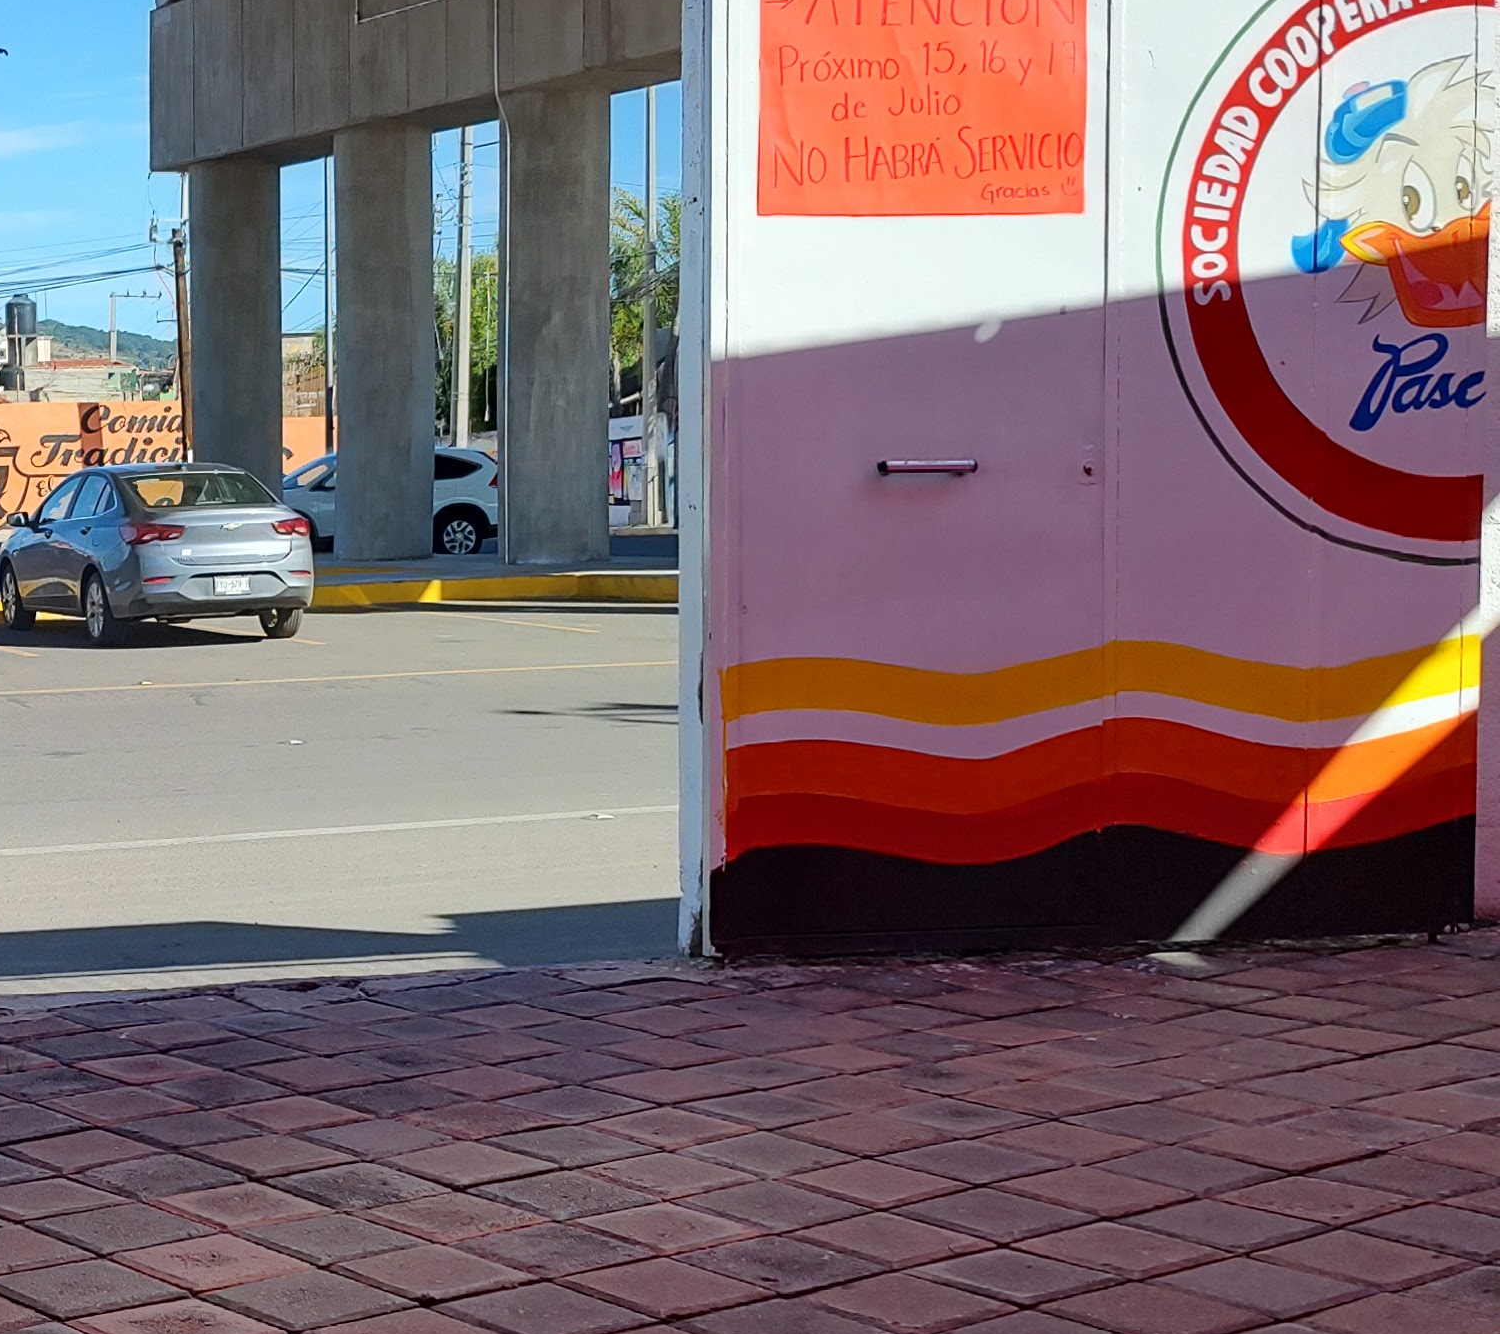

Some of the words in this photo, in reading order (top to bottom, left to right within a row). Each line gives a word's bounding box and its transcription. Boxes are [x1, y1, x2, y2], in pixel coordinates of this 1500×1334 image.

[779, 44, 900, 86] Próximo
[922, 40, 967, 76] 15,
[979, 40, 1006, 75] 16
[1018, 56, 1033, 86] y
[1047, 40, 1077, 76] 17
[831, 92, 868, 122] de
[888, 83, 961, 117] Julio
[774, 140, 827, 189] NO
[844, 135, 945, 183] HABRÁ
[954, 126, 1083, 179] SERVICIO
[981, 182, 1051, 204] Gracias
[1190, 105, 1260, 306] SOCIEDAD
